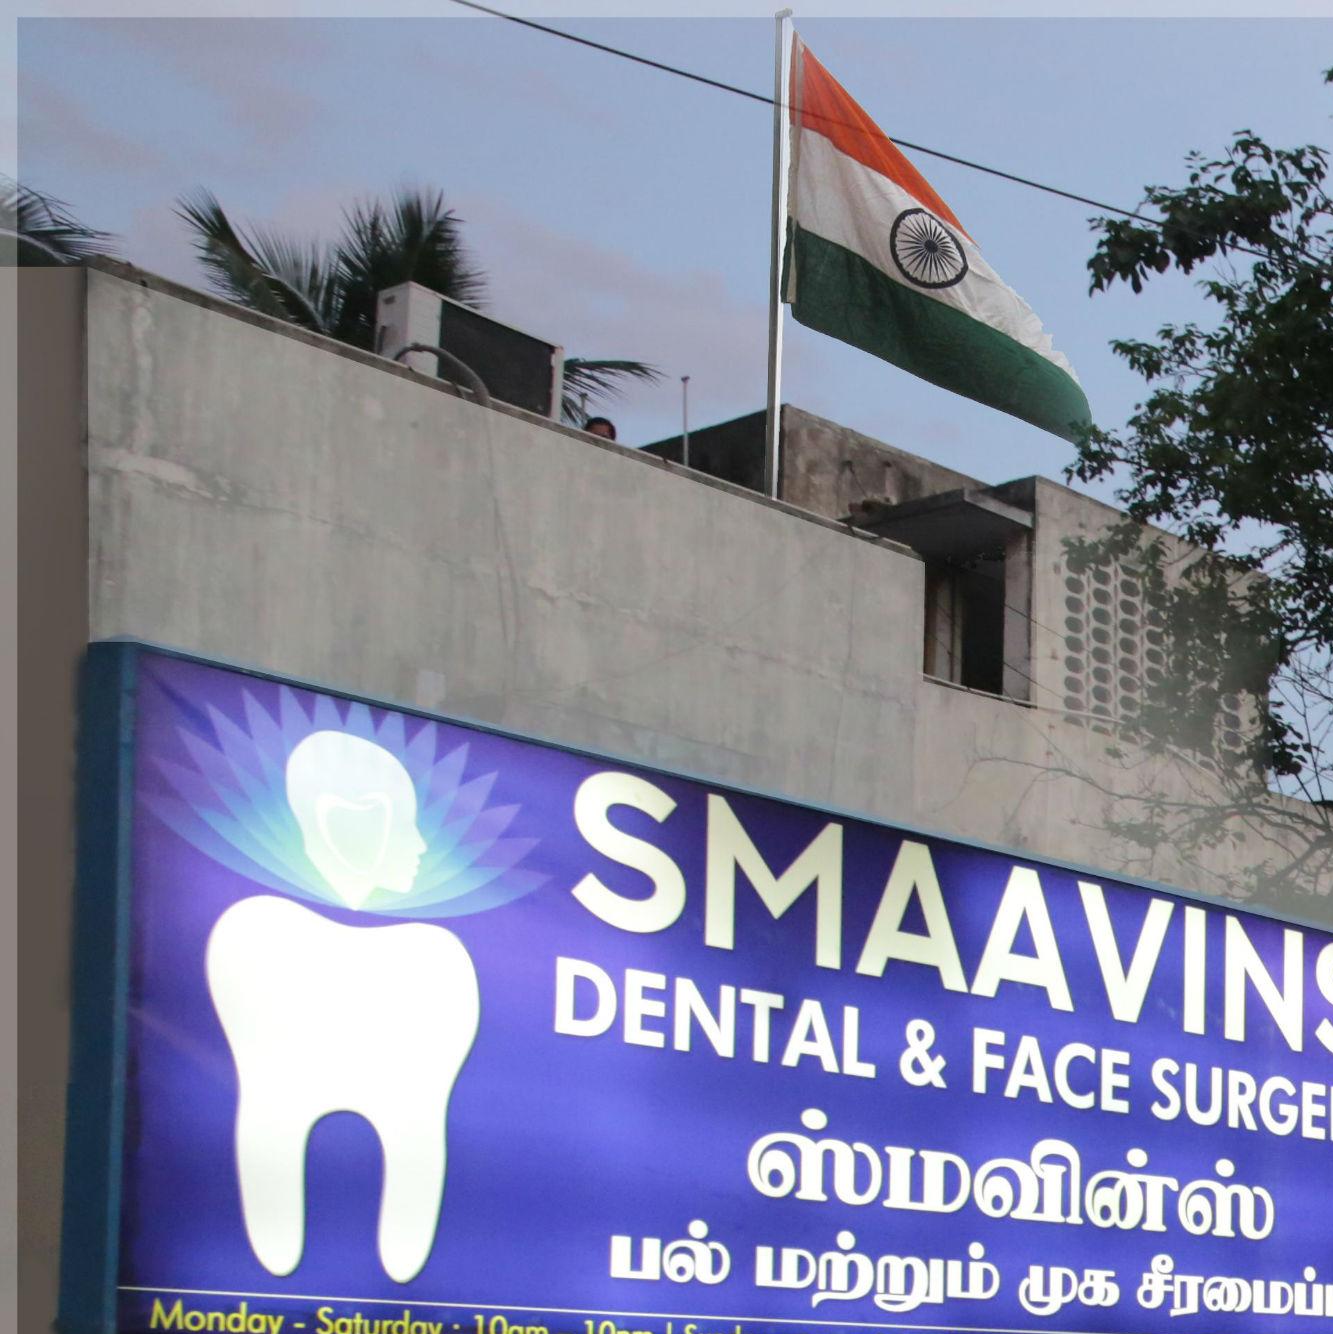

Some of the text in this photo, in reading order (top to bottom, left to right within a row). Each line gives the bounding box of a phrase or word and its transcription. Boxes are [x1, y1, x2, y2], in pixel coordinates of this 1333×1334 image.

[554, 956, 876, 1081] DENTAL
[898, 1019, 948, 1088] &
[973, 1020, 1132, 1114] FACE
[610, 1220, 730, 1286] பல்
[754, 1230, 1000, 1312] மற்றும்
[1018, 1262, 1120, 1316] முக
